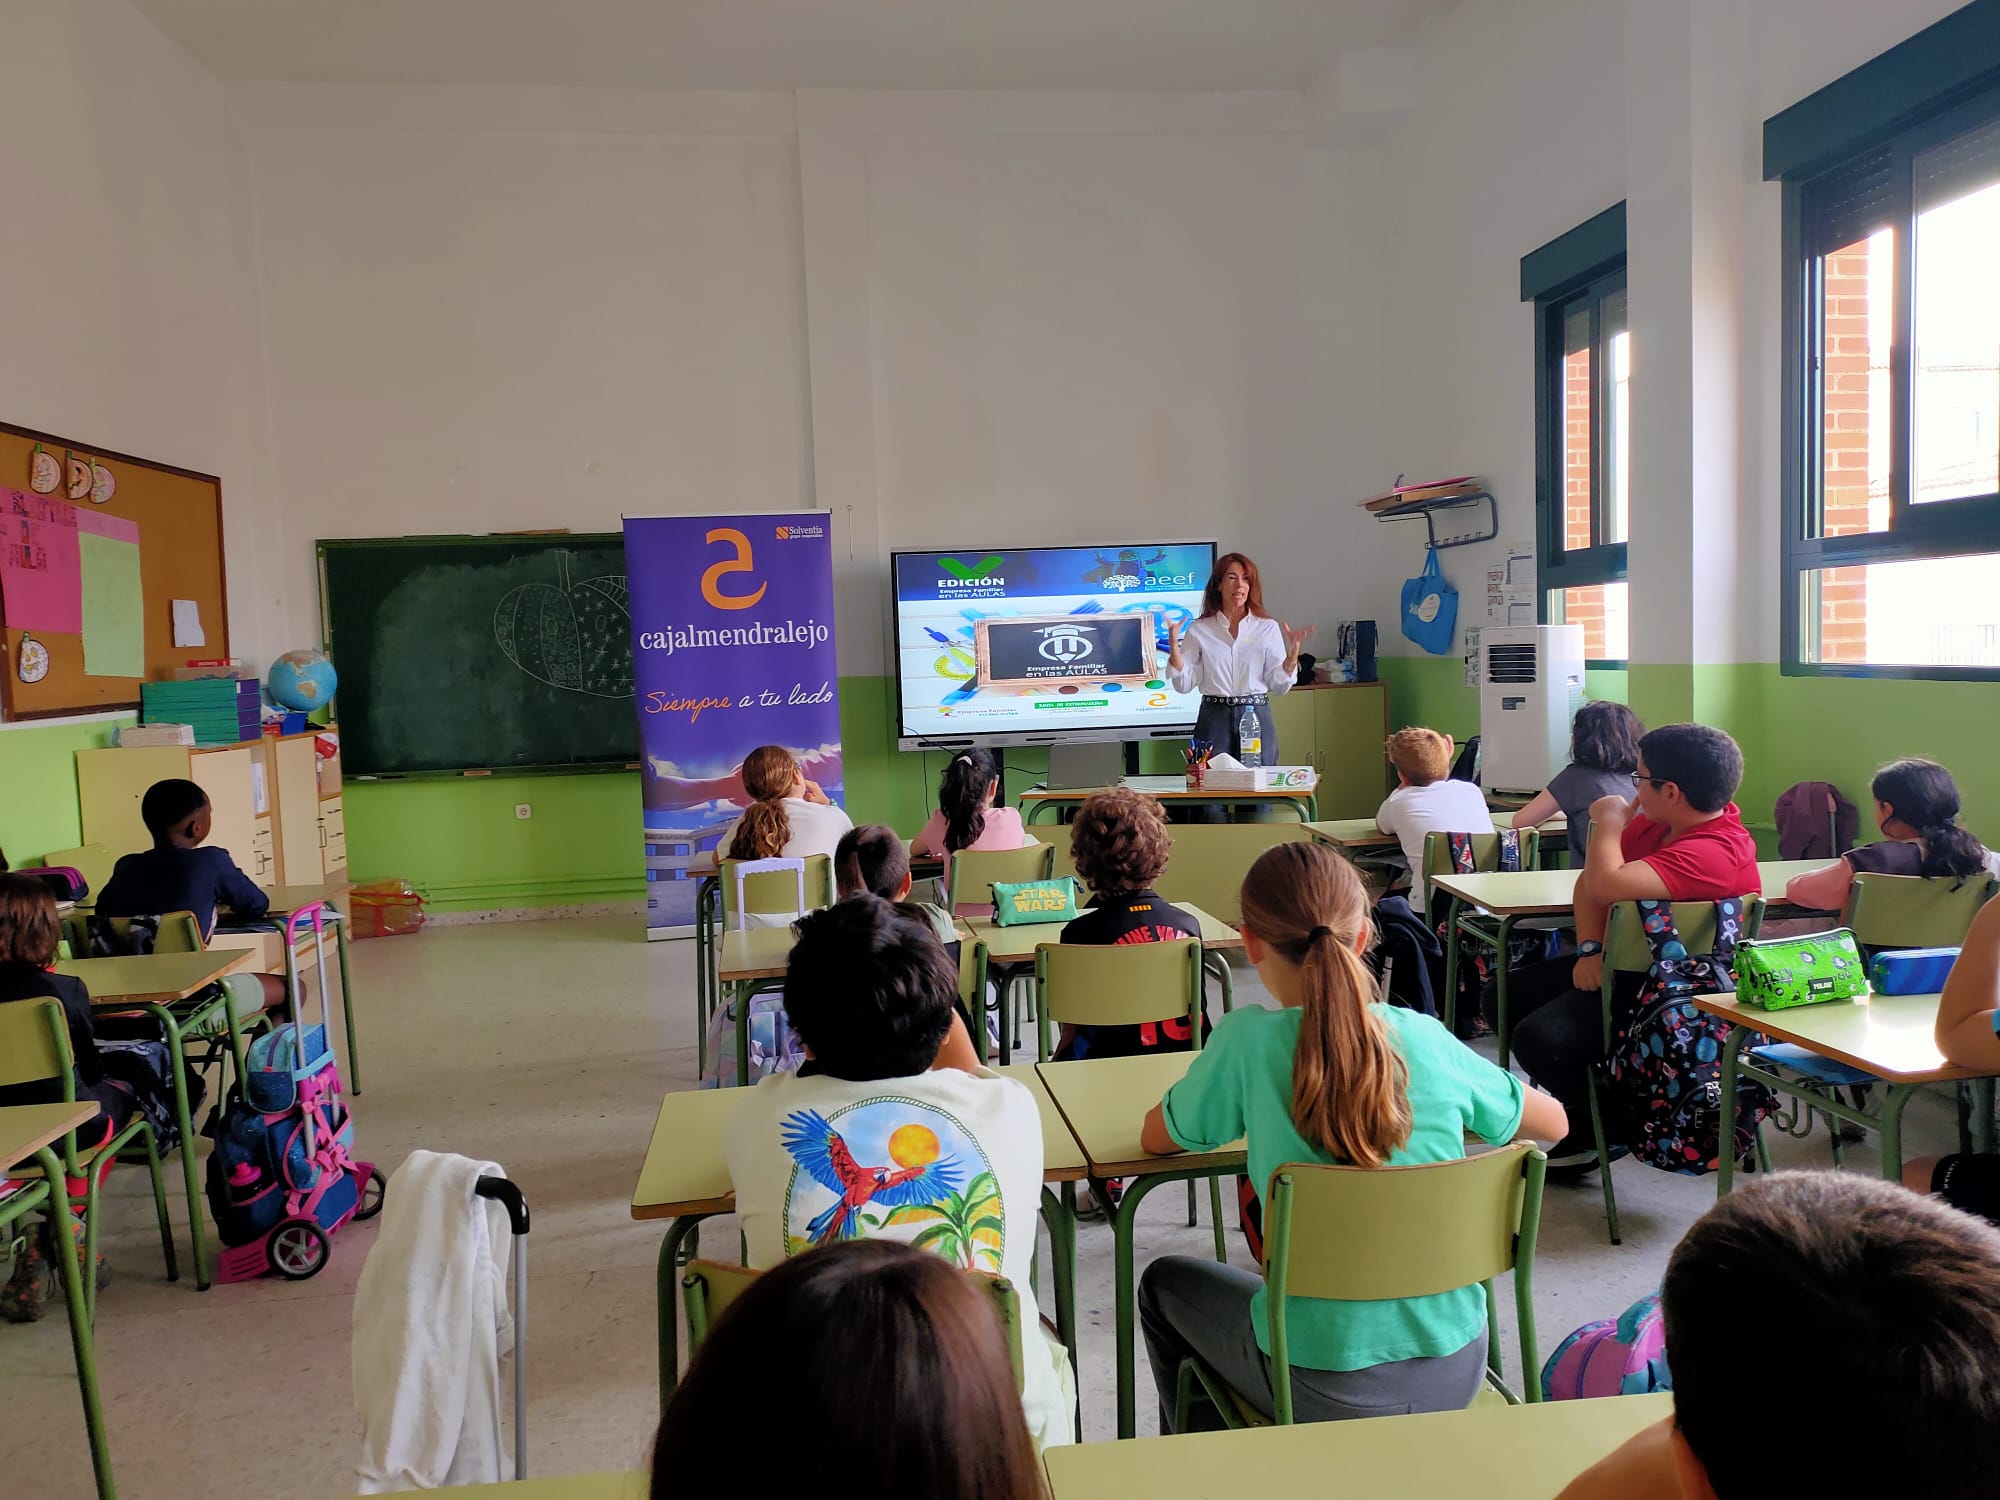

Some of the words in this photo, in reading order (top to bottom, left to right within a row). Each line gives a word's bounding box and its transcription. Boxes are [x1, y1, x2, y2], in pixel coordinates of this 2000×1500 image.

[789, 526, 823, 535] Solventia
[937, 576, 1005, 588] EDICIÓN
[1145, 572, 1195, 586] aeef
[639, 619, 829, 656] cajalmendralejo
[1066, 667, 1108, 676] AULAS
[645, 691, 732, 725] Siempre
[739, 695, 754, 708] a
[758, 688, 782, 707] tu
[787, 681, 834, 706] lado
[1013, 888, 1067, 900] STAR
[1014, 898, 1068, 913] WARS
